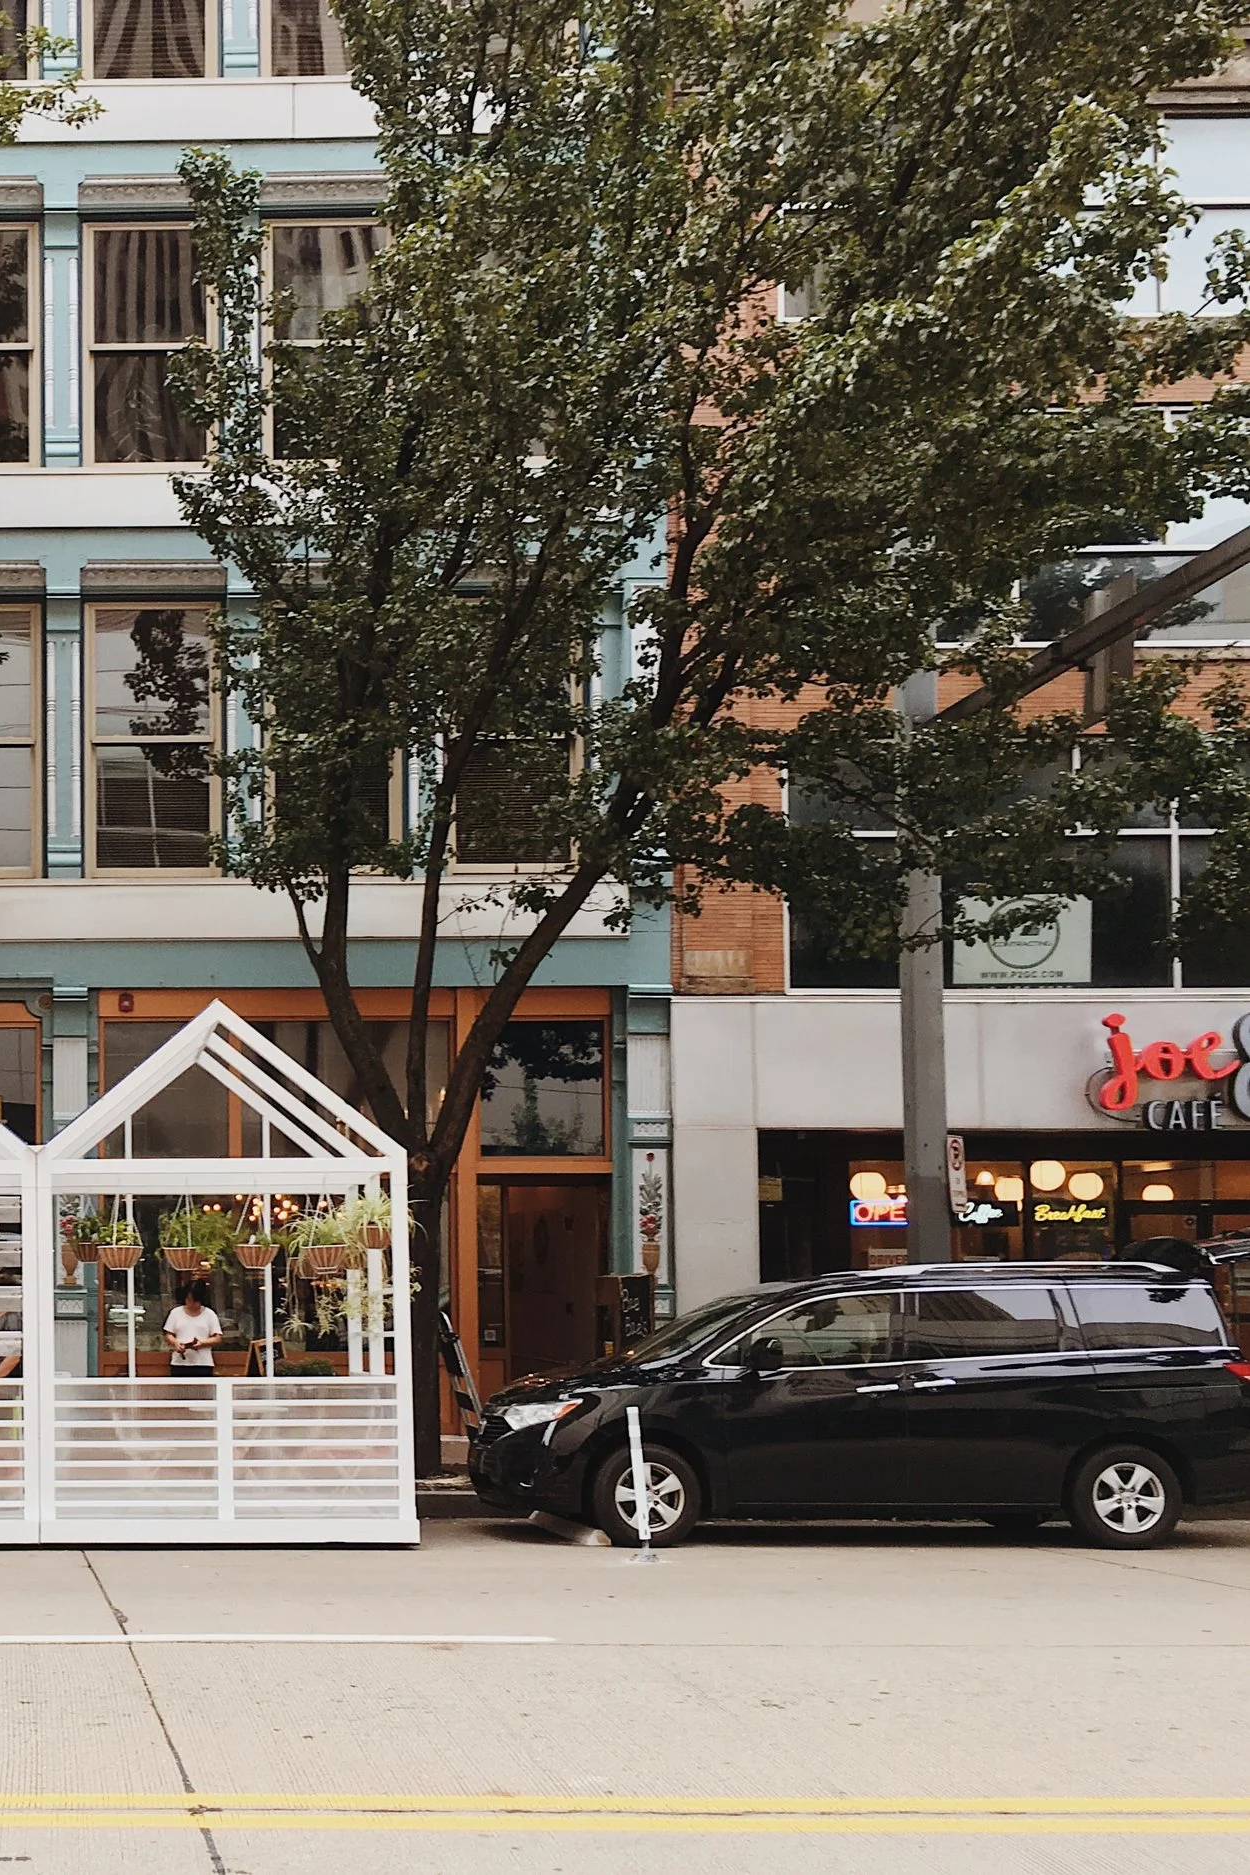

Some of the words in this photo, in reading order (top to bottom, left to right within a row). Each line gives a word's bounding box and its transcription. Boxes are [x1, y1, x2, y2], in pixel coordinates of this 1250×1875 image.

[1099, 1013, 1241, 1110] joe
[1145, 1092, 1223, 1130] CAFÉ
[854, 1203, 907, 1221] OPE
[1034, 1203, 1106, 1223] Breakfast
